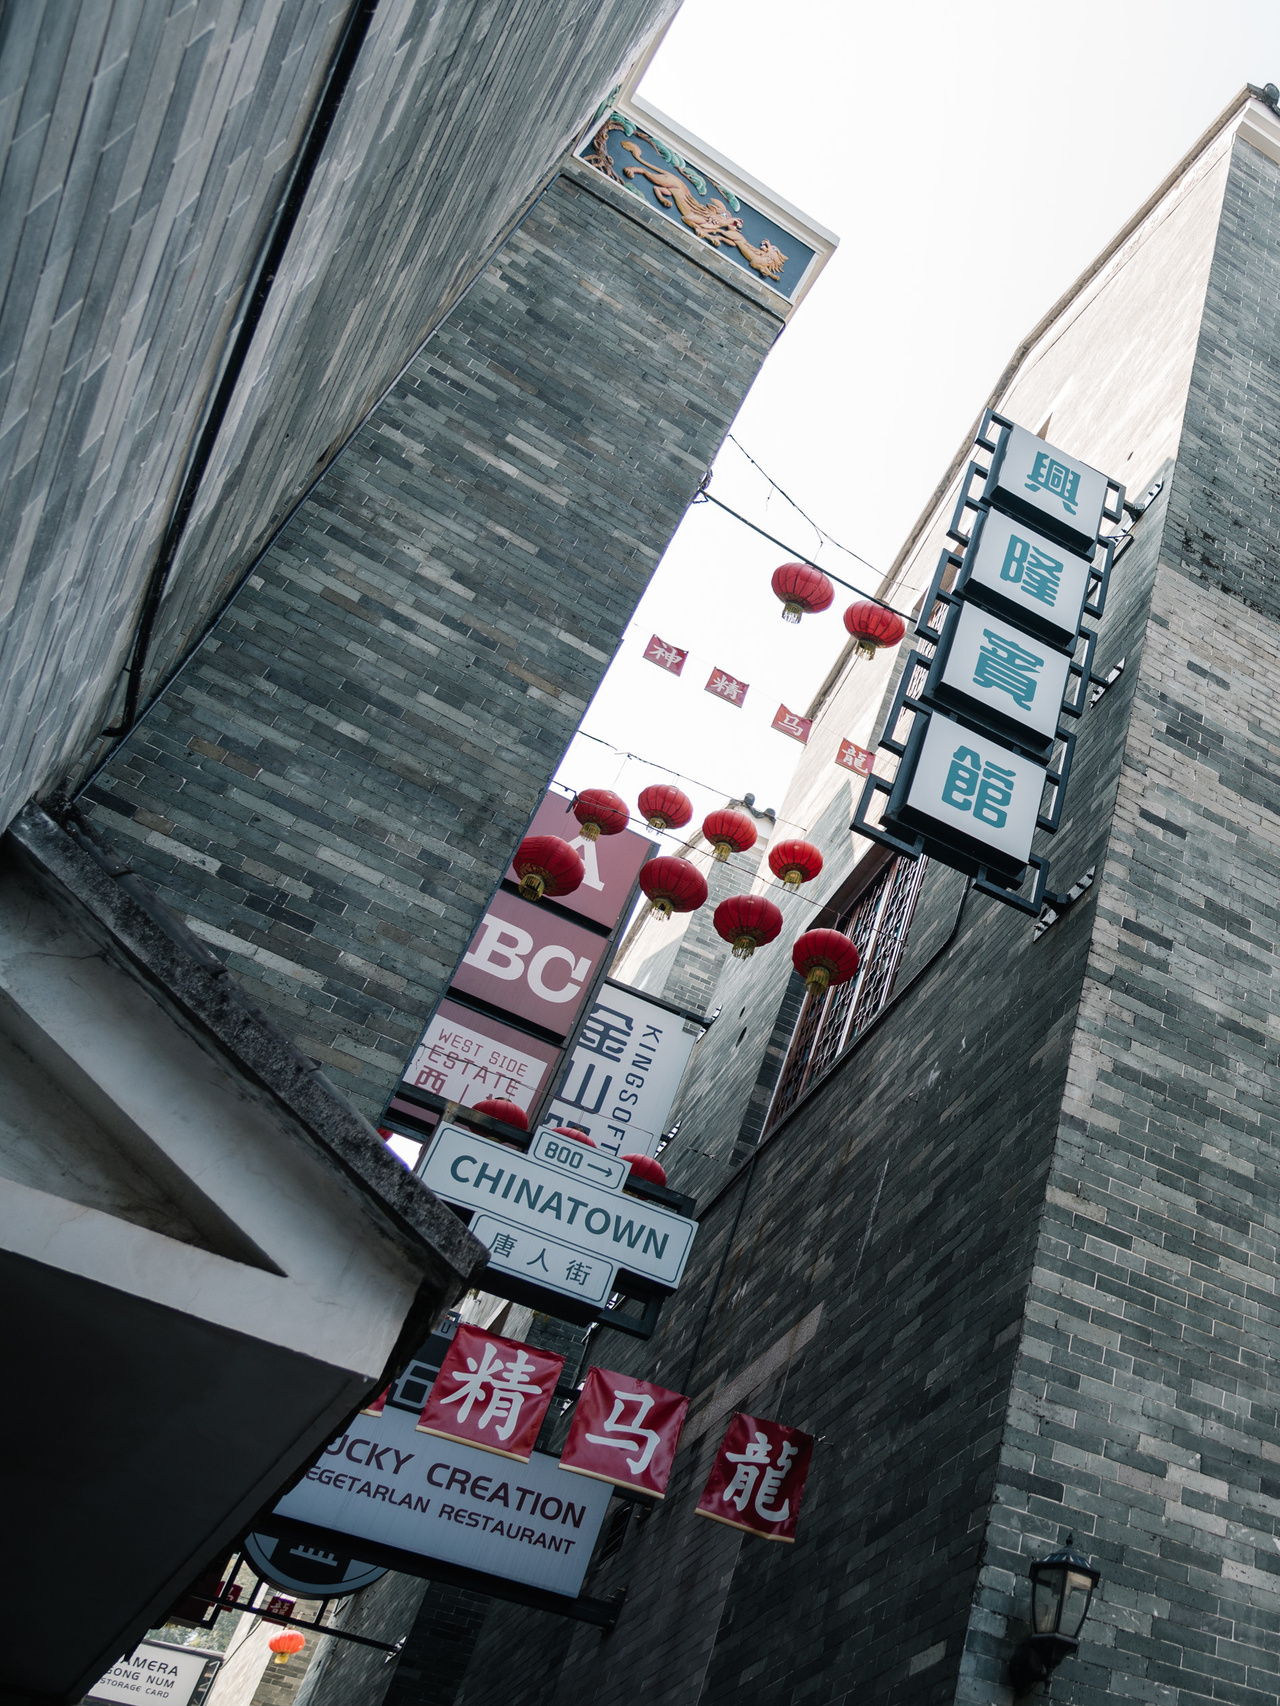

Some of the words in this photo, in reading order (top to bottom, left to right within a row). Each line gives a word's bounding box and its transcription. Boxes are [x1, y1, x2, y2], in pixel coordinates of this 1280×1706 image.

[649, 643, 682, 667] 神
[710, 674, 743, 700] 精
[778, 713, 803, 737] 马
[841, 745, 869, 774] 龍
[428, 1044, 521, 1097] ESTATE
[438, 1028, 484, 1057] WEST
[488, 1051, 528, 1078] SIDE
[601, 1024, 663, 1156] KINGSOFT
[544, 1141, 583, 1169] 800
[450, 1154, 670, 1260] CHINATOWN
[489, 1231, 593, 1286] 唐人街
[440, 1342, 543, 1441] 精
[585, 1390, 661, 1475] 马
[324, 1434, 415, 1475] UCKY
[426, 1462, 586, 1528] CREATION
[723, 1431, 799, 1522] 龍
[305, 1466, 431, 1514] EGETARLAN
[438, 1503, 576, 1555] RESTAURANT
[100, 1677, 142, 1692] STORAGE
[145, 1687, 169, 1698] CARD
[120, 1656, 178, 1677] AMERA
[146, 1675, 175, 1688] NUM
